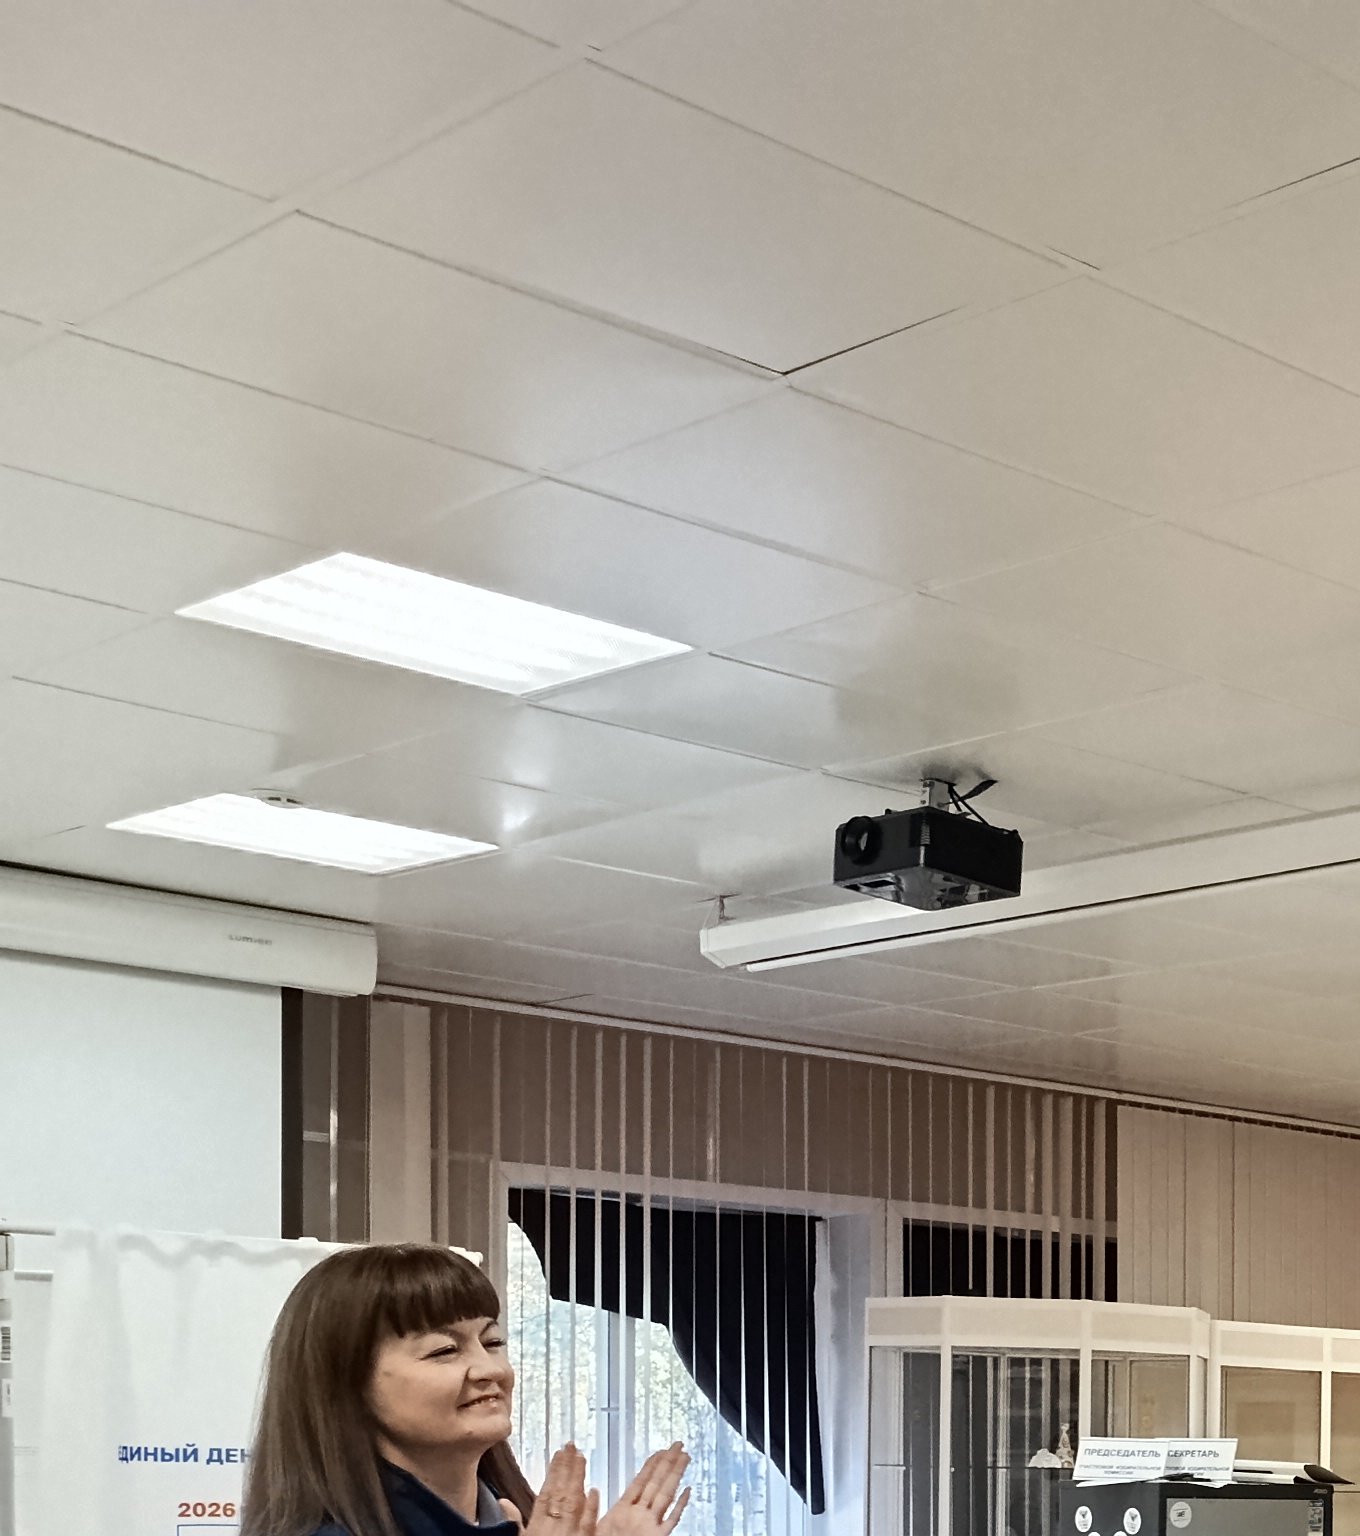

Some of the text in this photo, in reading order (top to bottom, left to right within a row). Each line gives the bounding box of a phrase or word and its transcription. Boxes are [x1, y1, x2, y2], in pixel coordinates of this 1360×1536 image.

[206, 1447, 251, 1465] ДЕН
[1084, 1448, 1160, 1458] ПРЕДСЕДАТЕЛЬ
[1167, 1450, 1219, 1458] СЕКРЕТАРЬ
[177, 1502, 236, 1518] 2026
